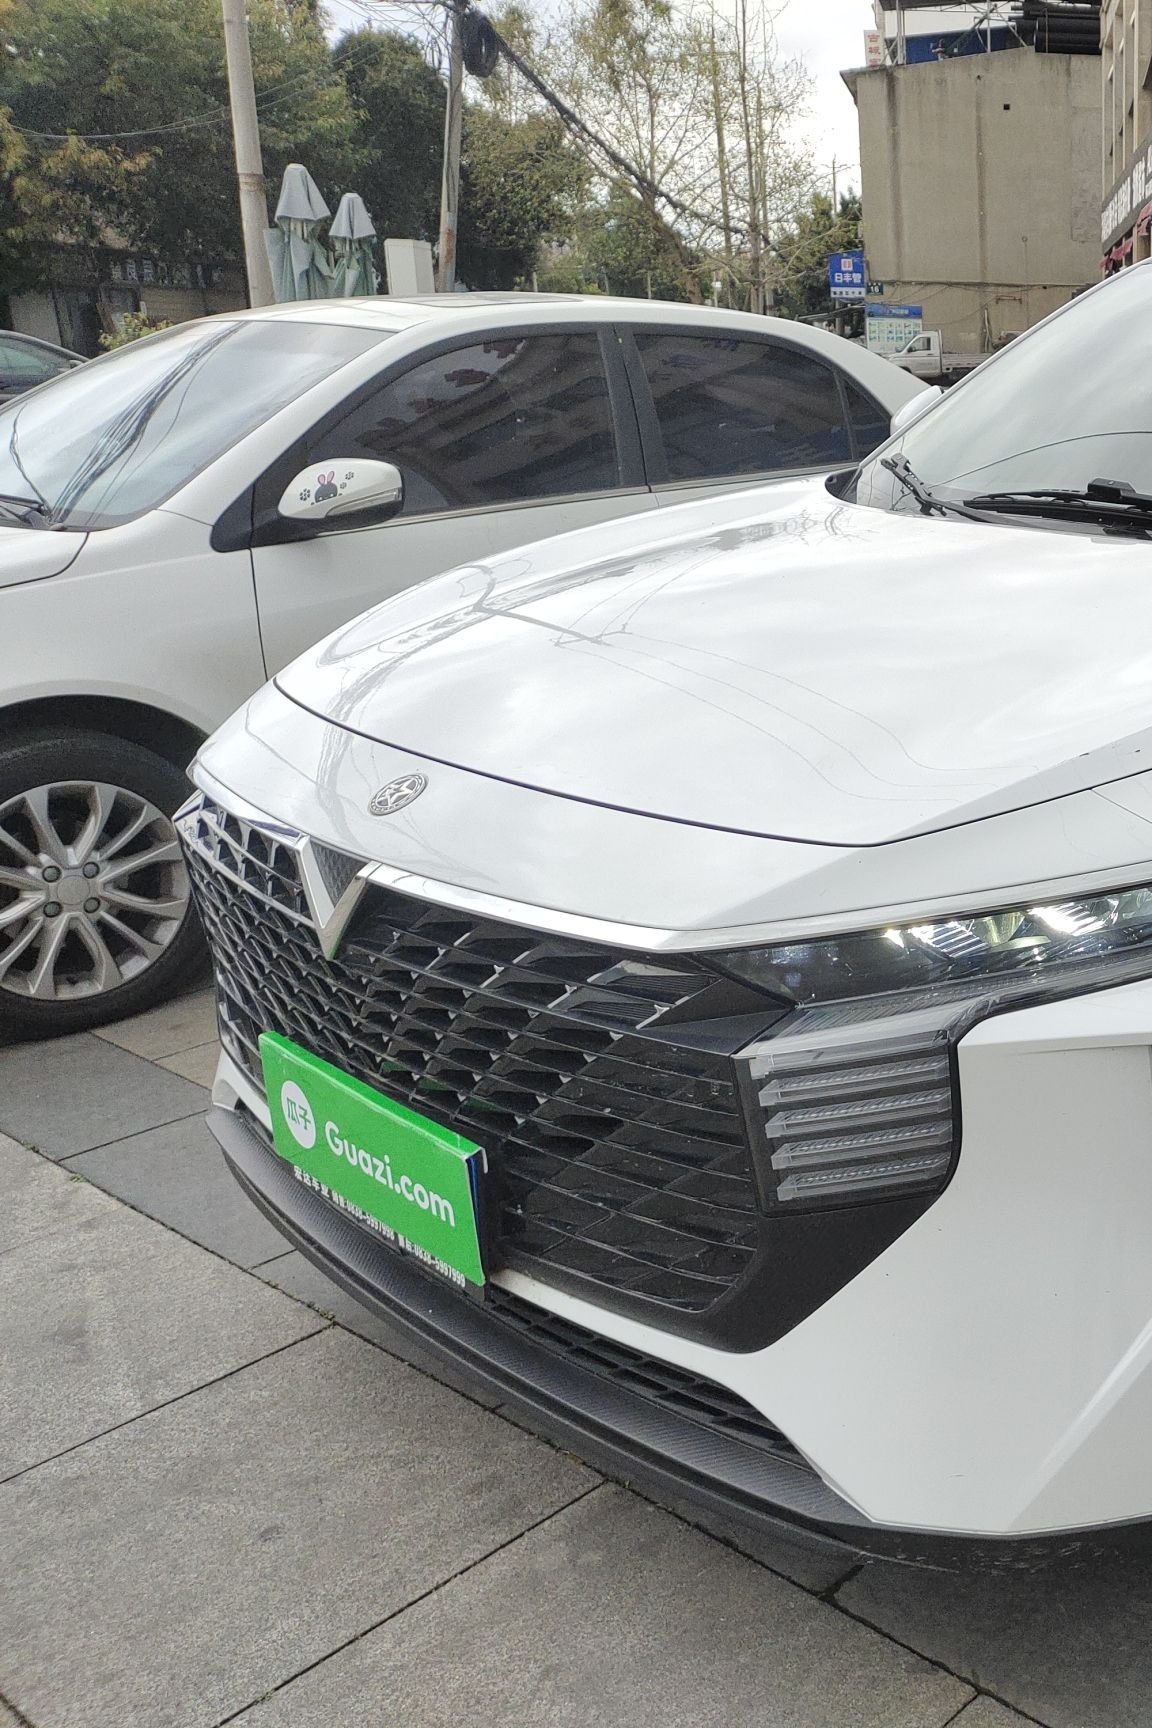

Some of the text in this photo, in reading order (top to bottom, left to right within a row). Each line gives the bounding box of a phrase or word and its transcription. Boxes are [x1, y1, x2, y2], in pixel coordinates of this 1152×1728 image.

[834, 272, 862, 283] 日丰管
[285, 1096, 312, 1131] 瓜子
[324, 1120, 456, 1228] Guazi.com
